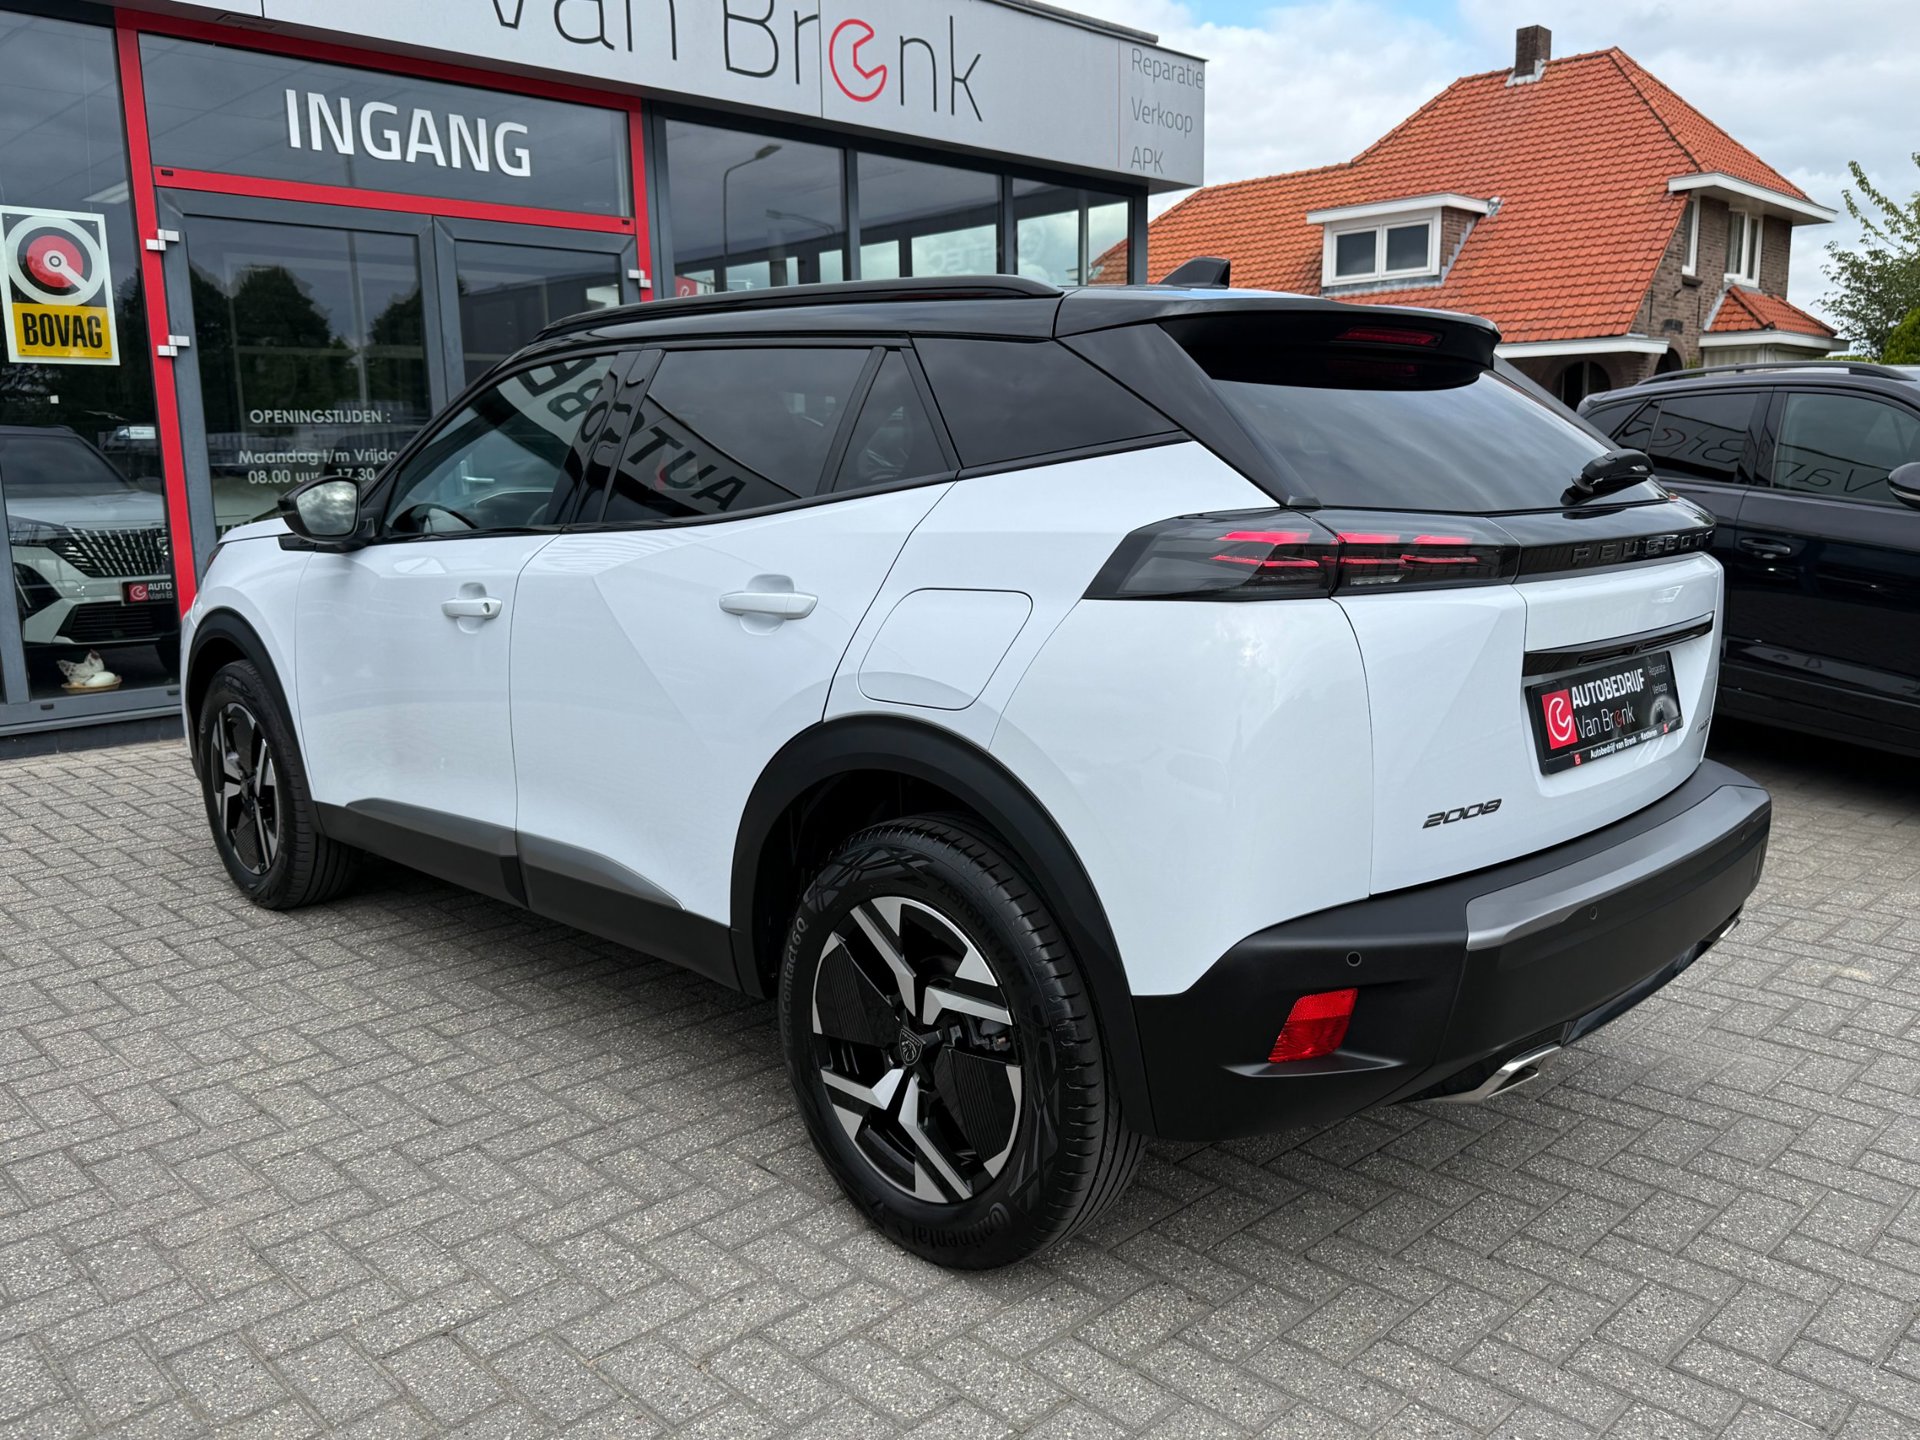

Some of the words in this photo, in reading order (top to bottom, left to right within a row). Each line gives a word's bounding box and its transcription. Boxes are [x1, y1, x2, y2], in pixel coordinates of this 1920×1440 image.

[1131, 47, 1204, 89] Reparatie
[286, 88, 531, 177] INGANG
[1131, 96, 1193, 138] Verkoop
[1130, 145, 1163, 174] APK
[22, 312, 103, 349] BOVAG
[250, 409, 382, 424] OPENINGSTIJDEN
[238, 449, 318, 466] Maandag
[354, 447, 398, 465] Vrijda
[249, 469, 291, 484] 08.00
[1571, 530, 1713, 567] PEUGEOT
[1571, 668, 1645, 709] AUTOBEDRIJF
[1575, 715, 1600, 739] Van
[1590, 742, 1616, 759] Autobedrijf
[1422, 798, 1502, 829] 2008
